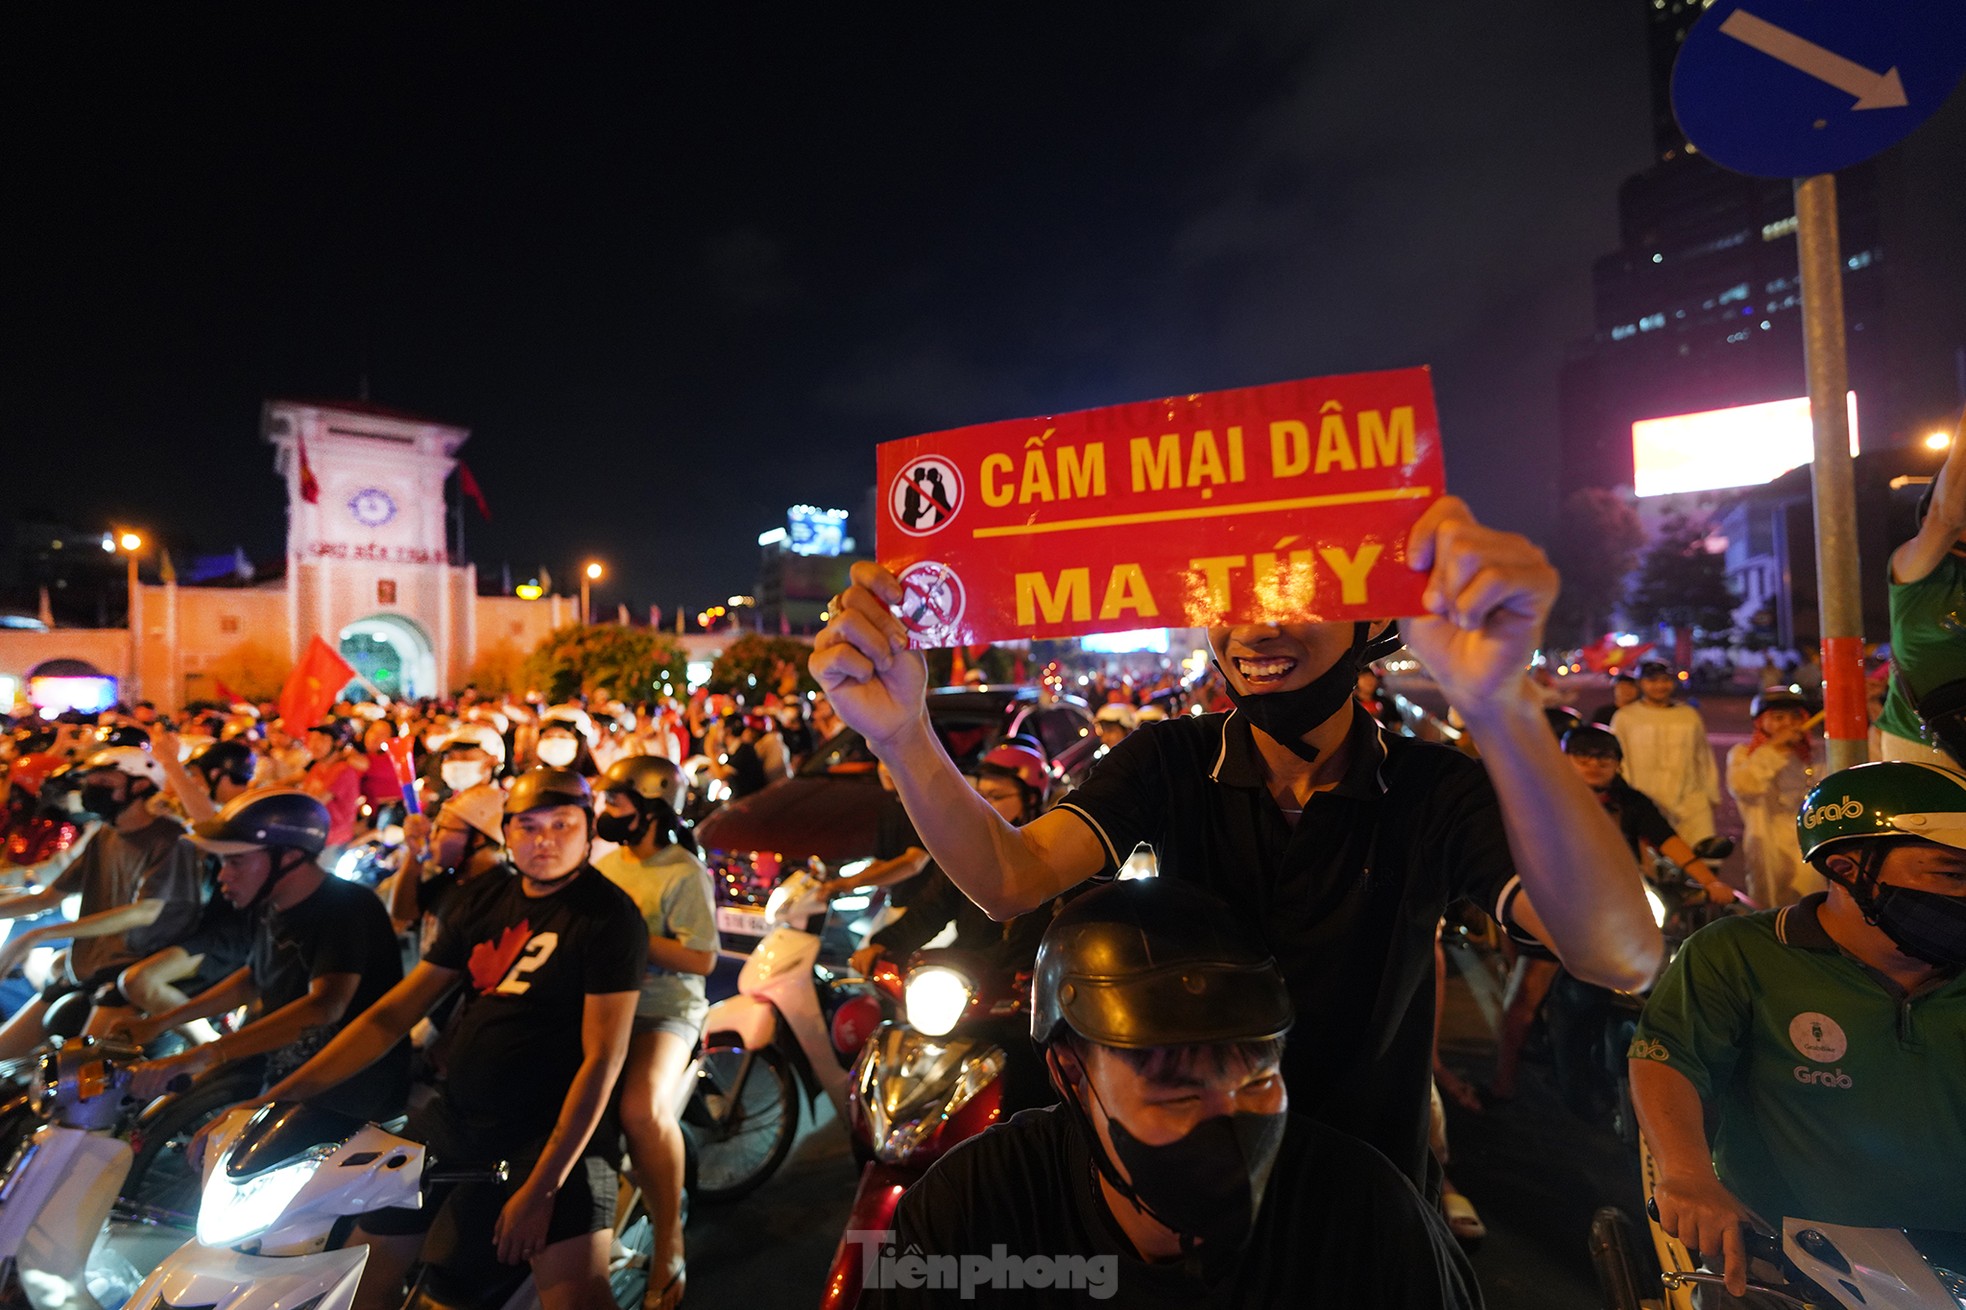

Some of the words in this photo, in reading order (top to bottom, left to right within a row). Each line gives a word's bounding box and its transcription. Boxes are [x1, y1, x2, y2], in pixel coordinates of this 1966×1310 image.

[980, 428, 1107, 508] CẤM
[1130, 426, 1246, 499] MẠI
[1269, 400, 1417, 479] DÂM
[1015, 563, 1160, 627] MA
[1188, 535, 1385, 614] TÚY
[1803, 795, 1864, 829] Grab
[496, 931, 559, 995] 2
[1793, 1065, 1853, 1089] Grab
